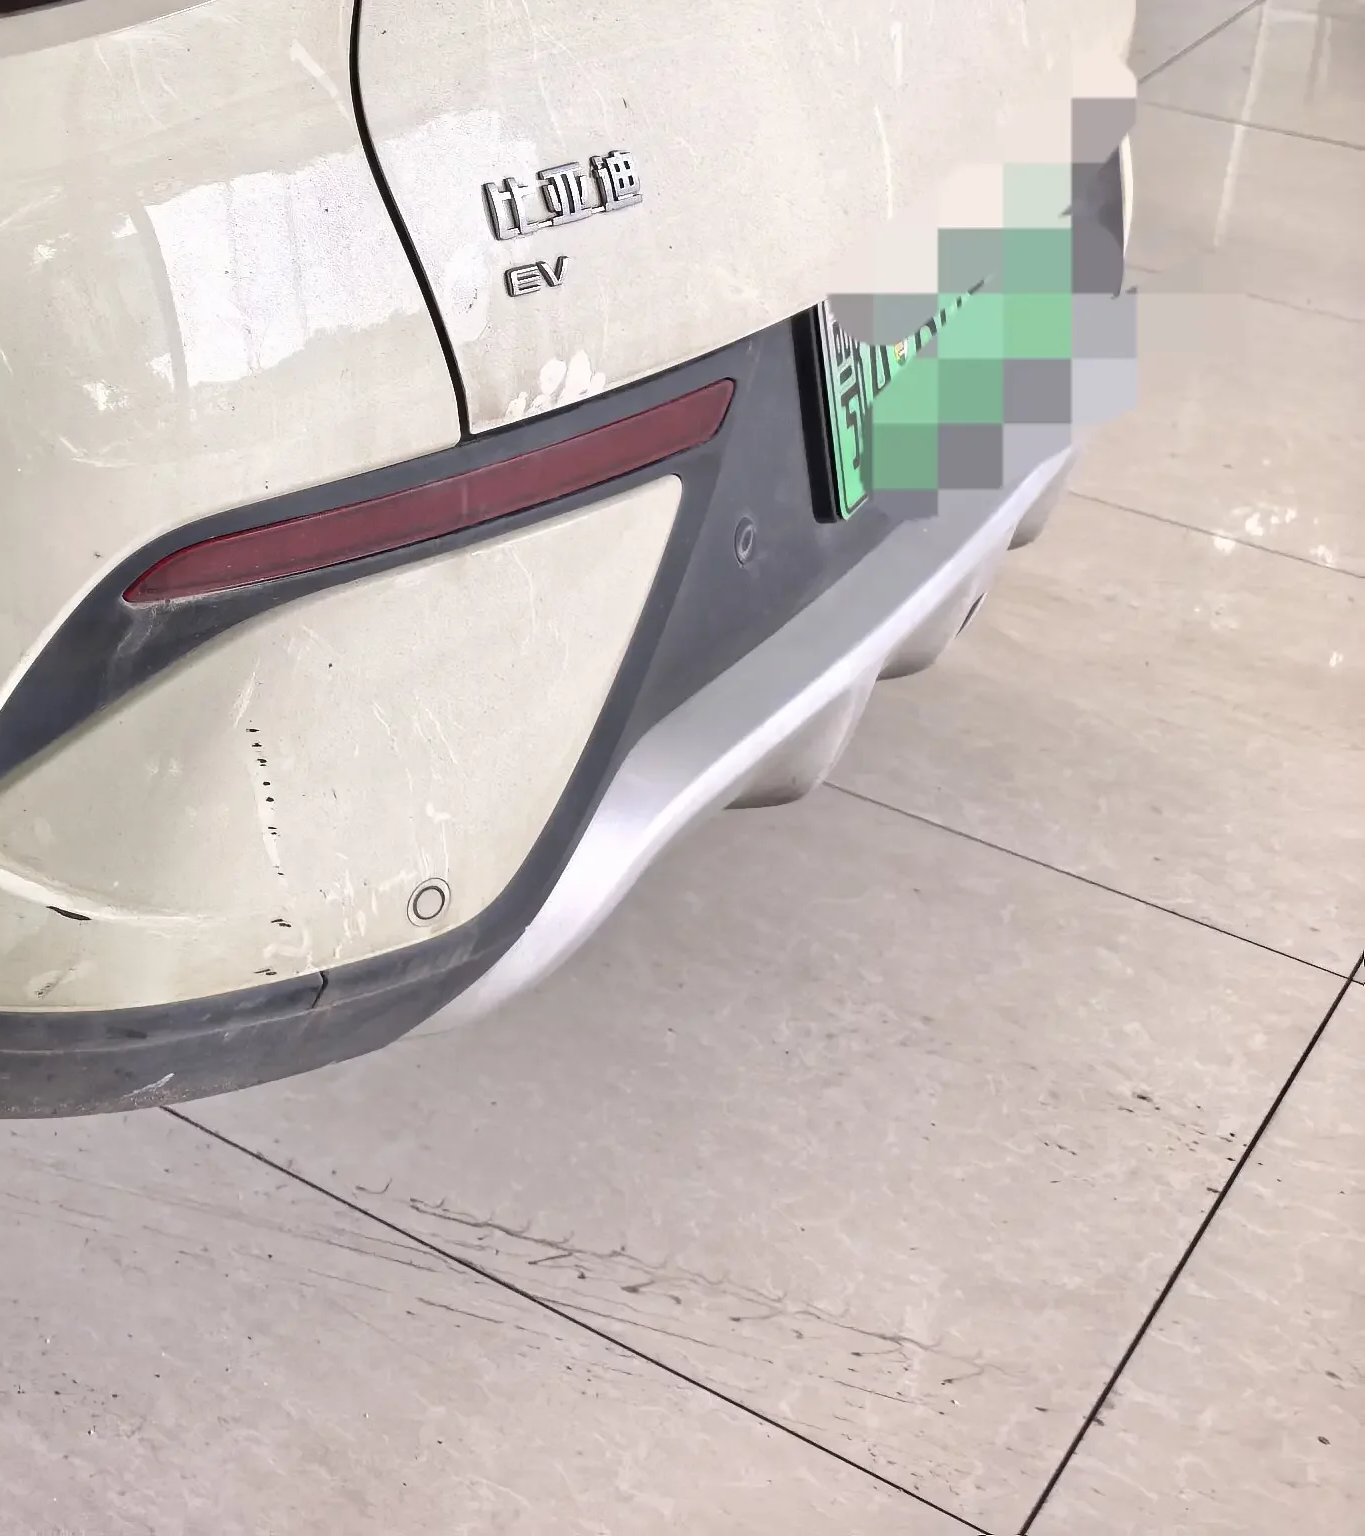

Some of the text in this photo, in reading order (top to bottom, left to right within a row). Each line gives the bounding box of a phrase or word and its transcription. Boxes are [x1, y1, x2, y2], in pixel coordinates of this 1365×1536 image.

[481, 149, 643, 241] 比亚迪
[503, 255, 570, 298] EV
